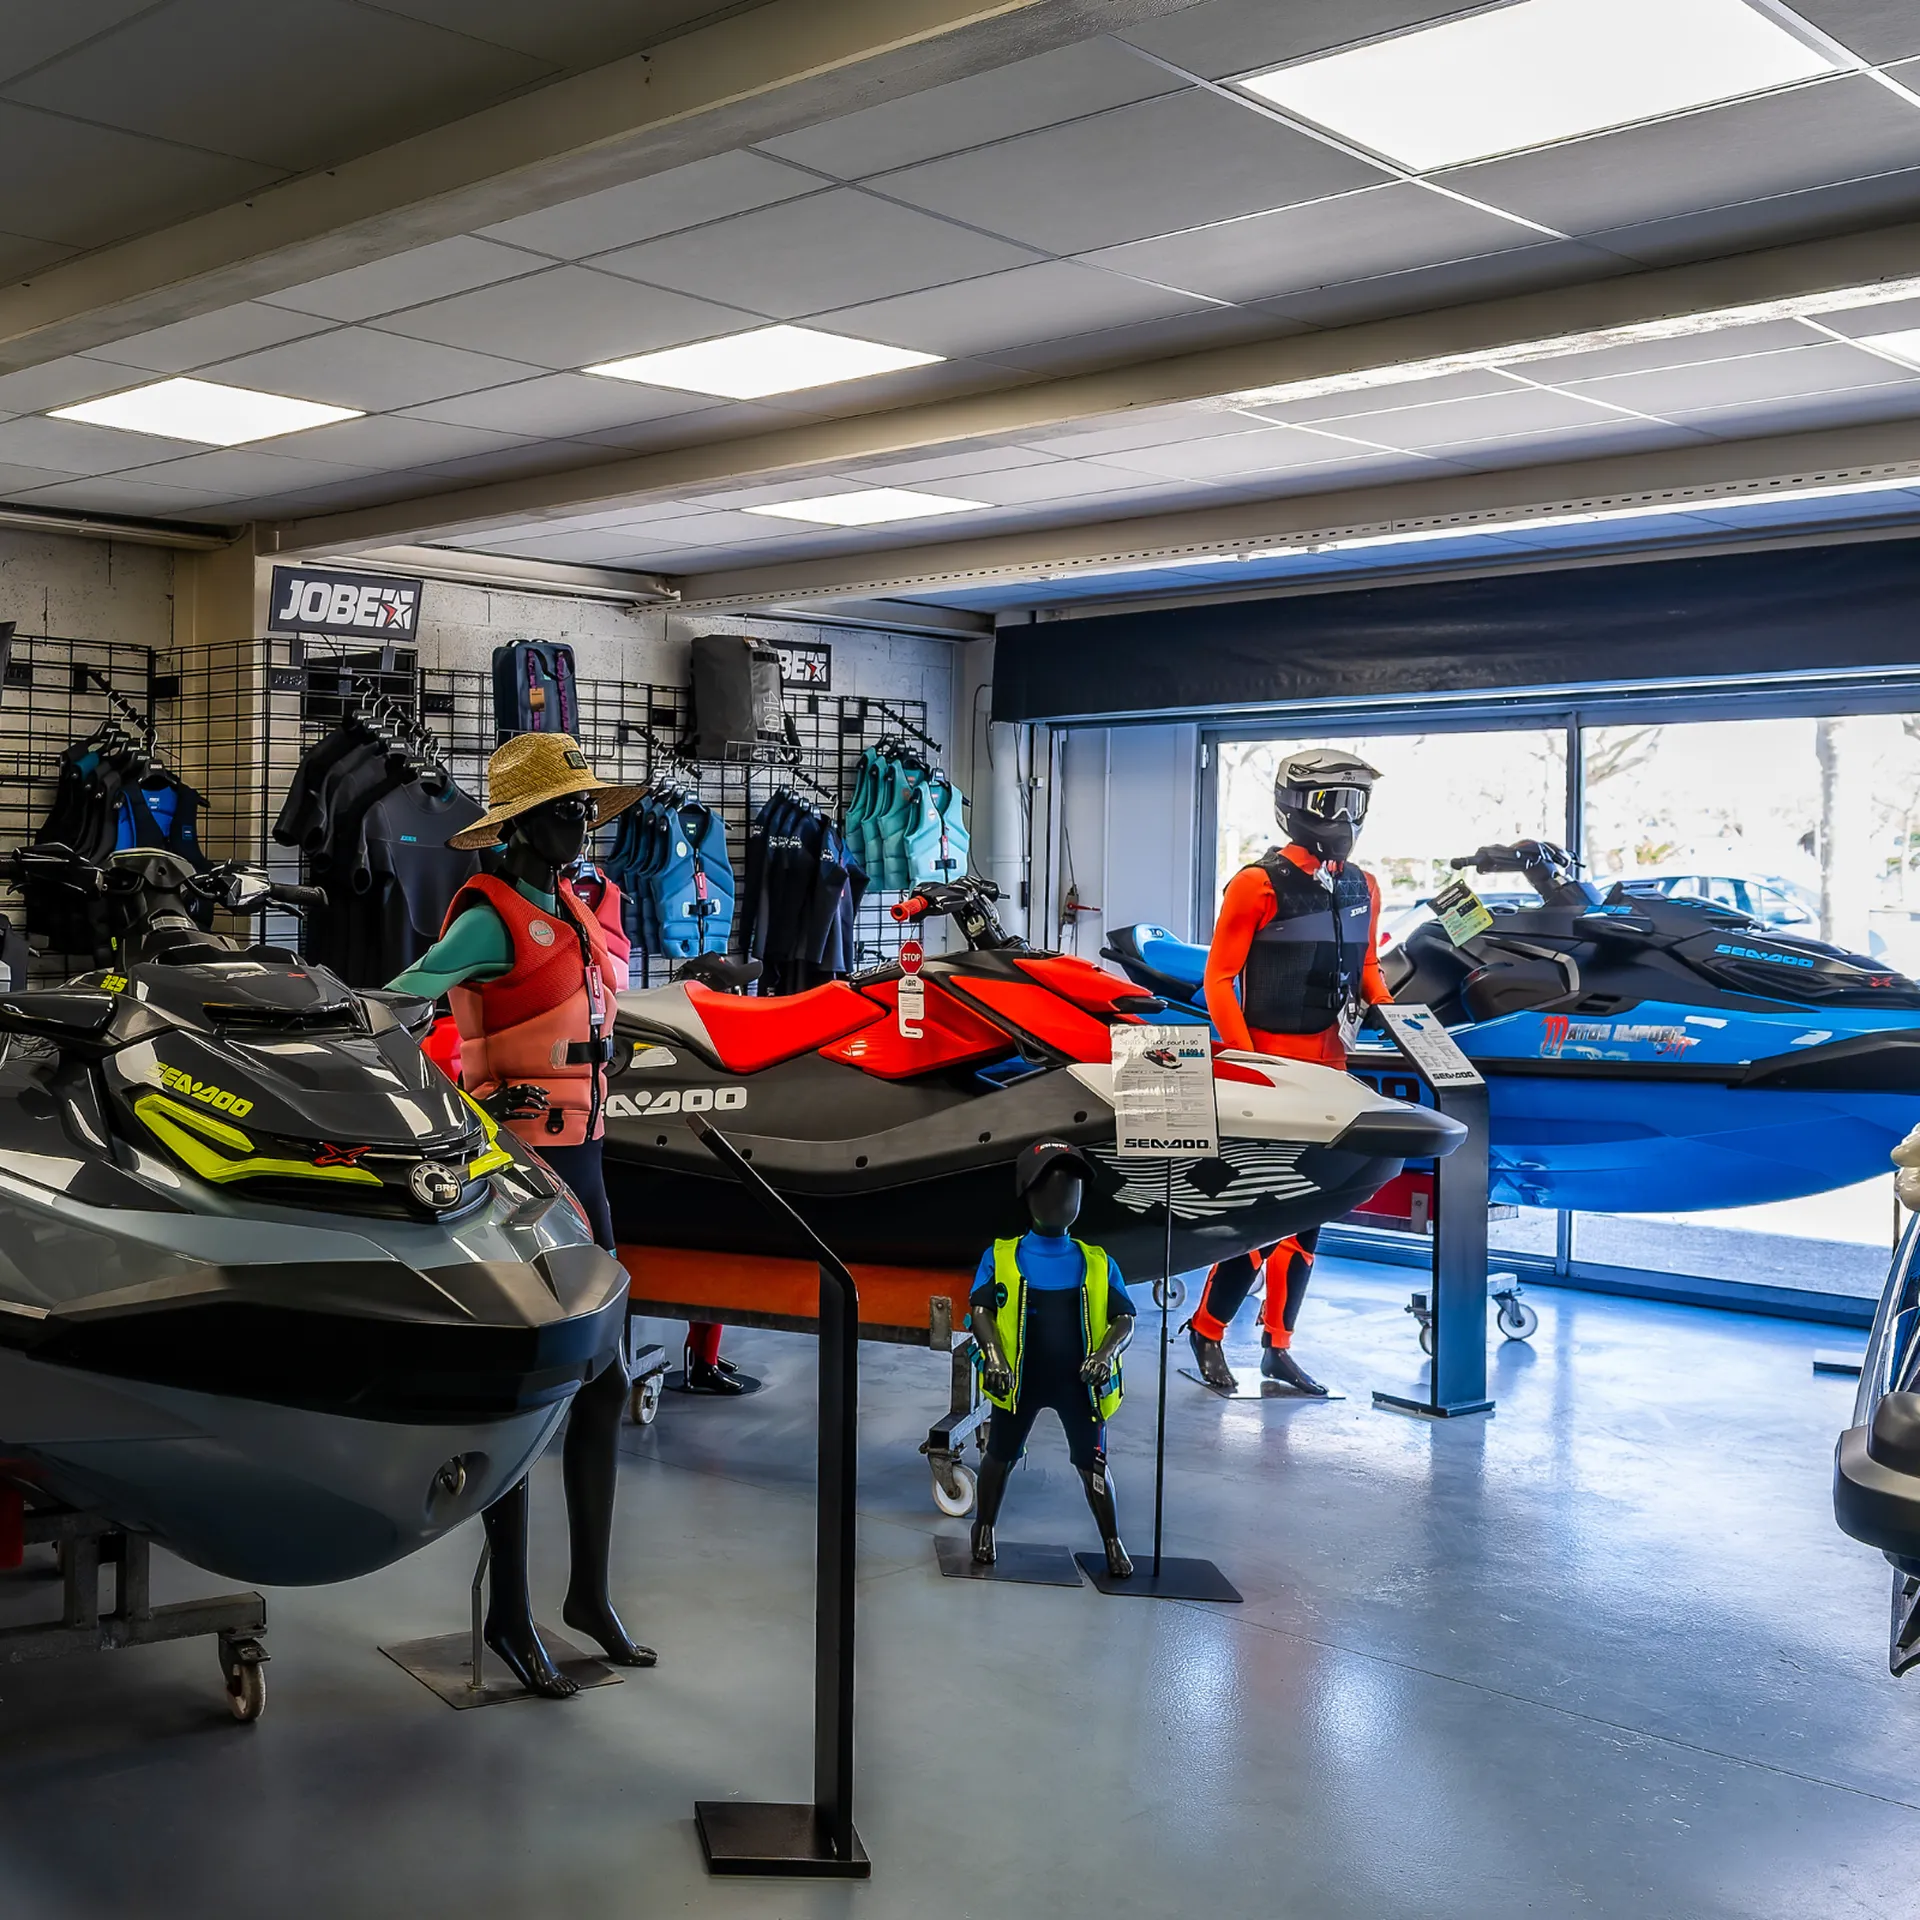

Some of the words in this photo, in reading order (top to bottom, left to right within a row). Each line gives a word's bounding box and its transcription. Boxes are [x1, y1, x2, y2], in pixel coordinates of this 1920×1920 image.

[279, 580, 382, 627] JOBE
[902, 953, 921, 961] STOP
[101, 974, 128, 993] 325
[435, 1183, 457, 1193] BRP
